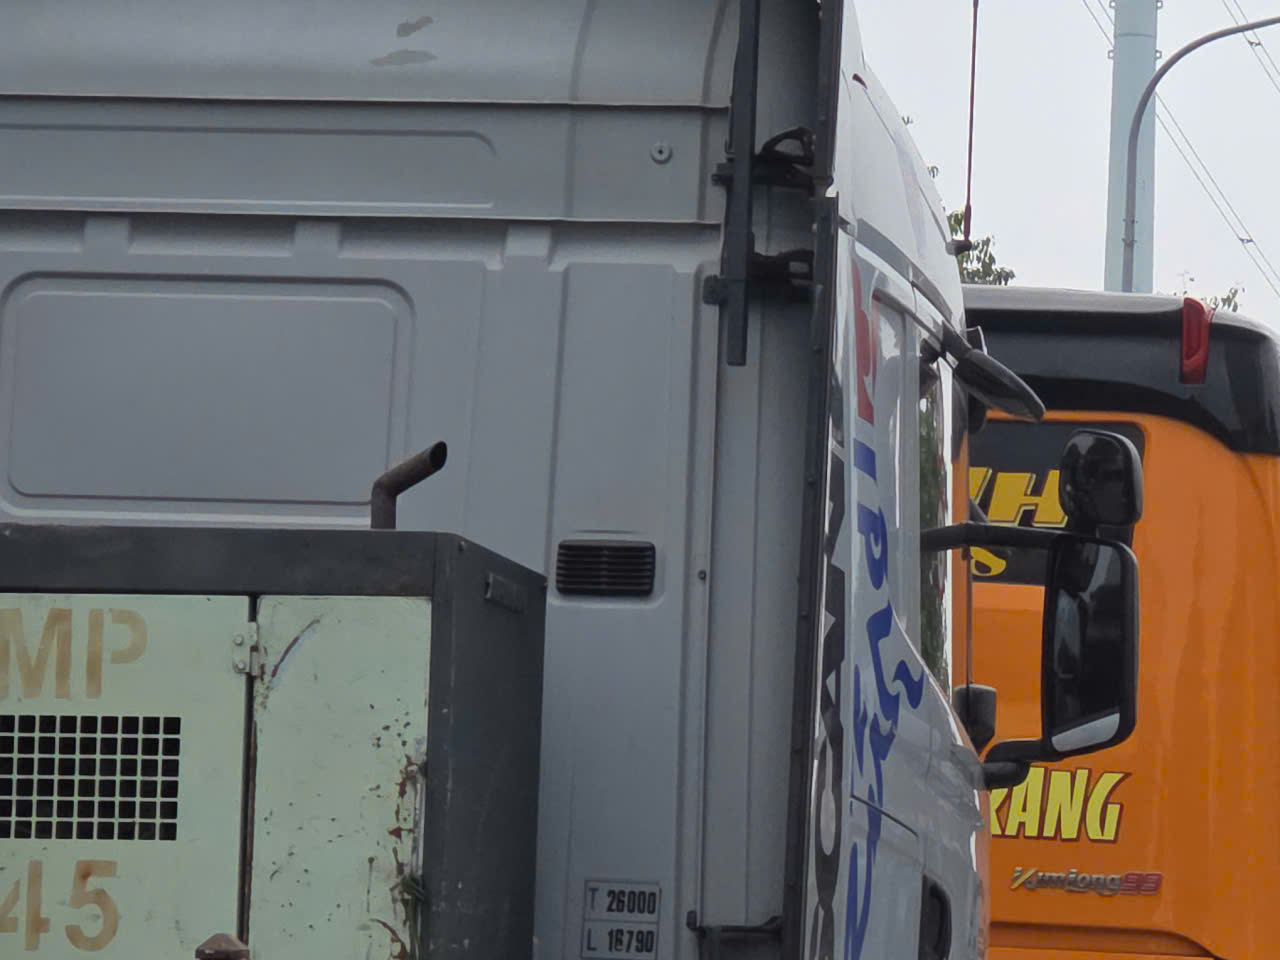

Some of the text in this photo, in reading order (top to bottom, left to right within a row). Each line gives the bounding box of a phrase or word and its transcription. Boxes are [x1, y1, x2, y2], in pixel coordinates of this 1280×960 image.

[0, 859, 120, 952] 45
[588, 887, 657, 915] T 26000
[586, 927, 598, 951] L
